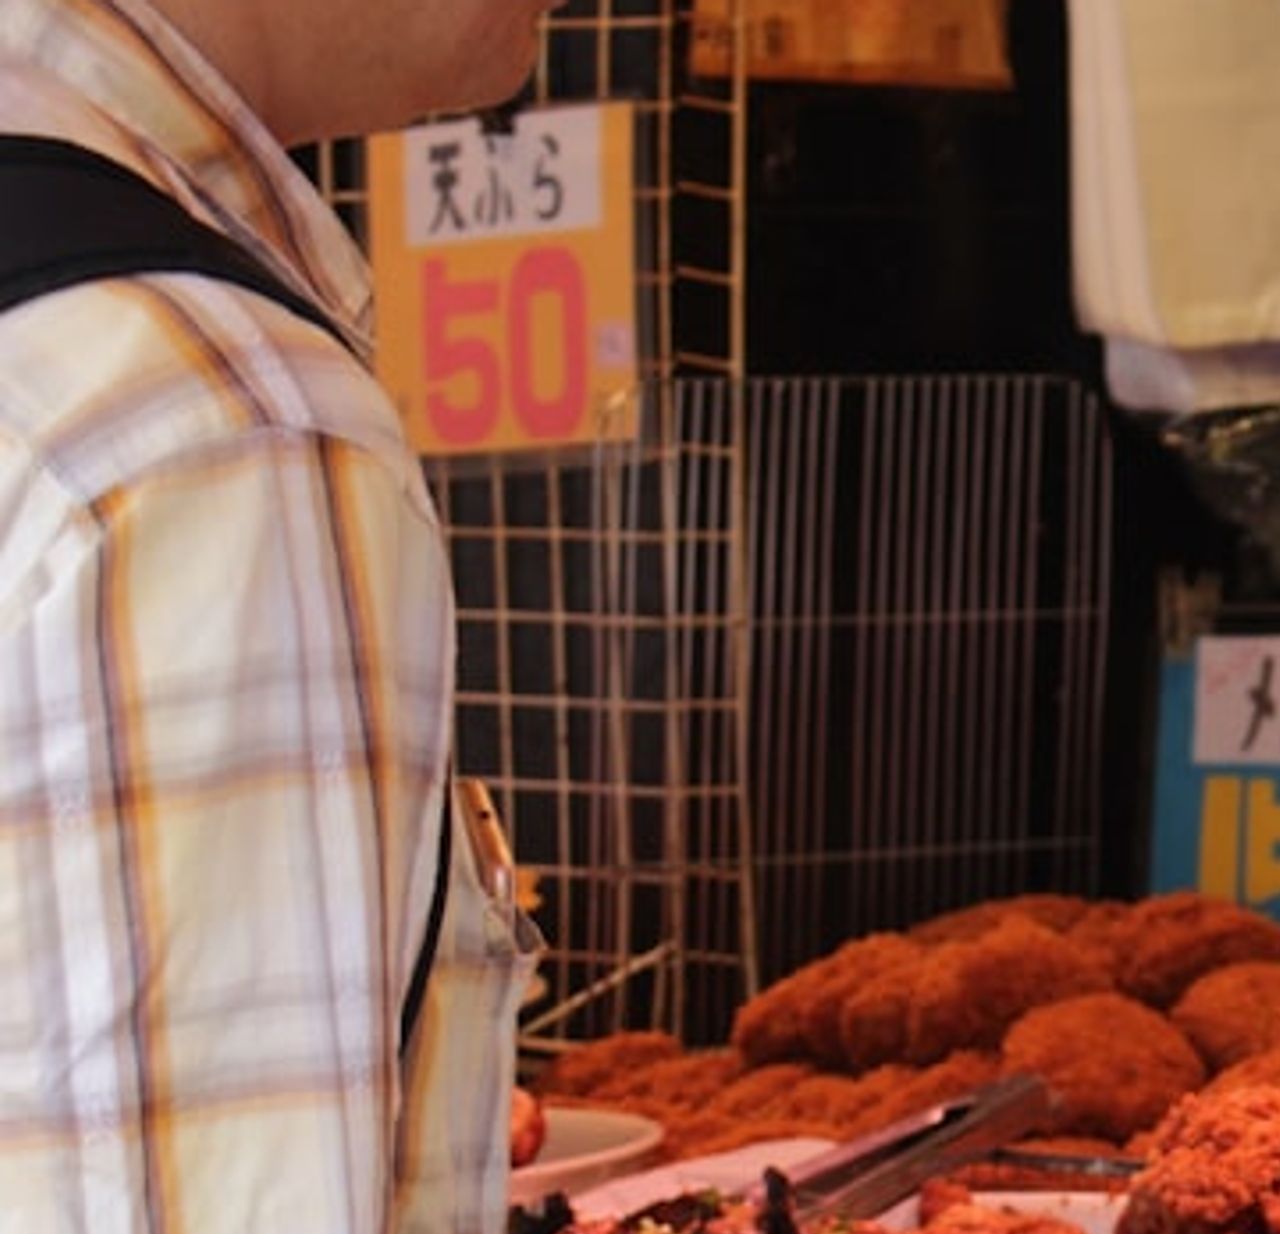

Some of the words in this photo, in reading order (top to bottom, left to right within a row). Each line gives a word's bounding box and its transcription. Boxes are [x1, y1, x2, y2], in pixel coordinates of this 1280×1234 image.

[427, 134, 564, 235] 天ぷら
[420, 245, 588, 445] 50
